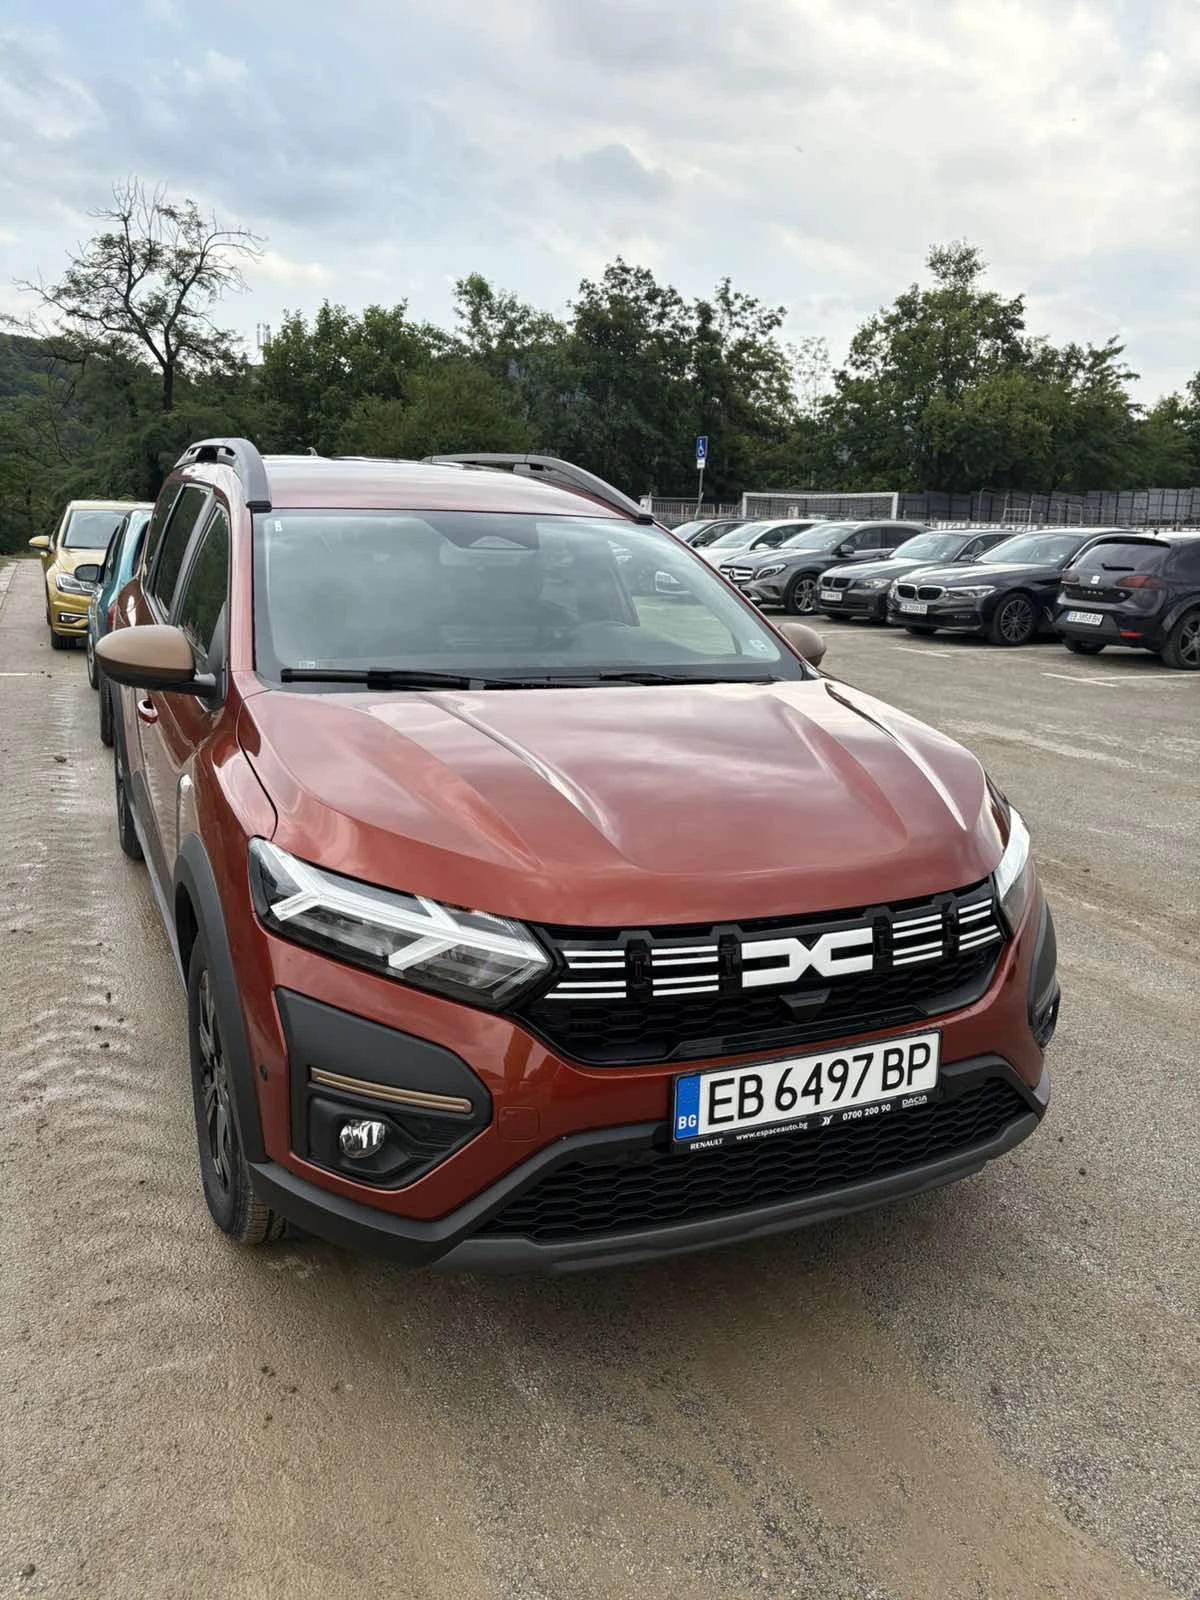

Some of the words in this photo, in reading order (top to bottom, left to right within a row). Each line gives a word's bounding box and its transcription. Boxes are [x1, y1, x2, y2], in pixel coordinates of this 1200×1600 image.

[707, 1073, 764, 1126] EB
[774, 1052, 875, 1112] 6497
[881, 1042, 932, 1092] BP
[902, 1095, 928, 1106] DACIA
[842, 1109, 863, 1121] 0700
[864, 1106, 880, 1117] 200
[881, 1103, 891, 1113] 90
[678, 1113, 698, 1130] BG
[736, 1121, 809, 1141] www.espaceauto.bg
[690, 1137, 724, 1151] RENAULT
